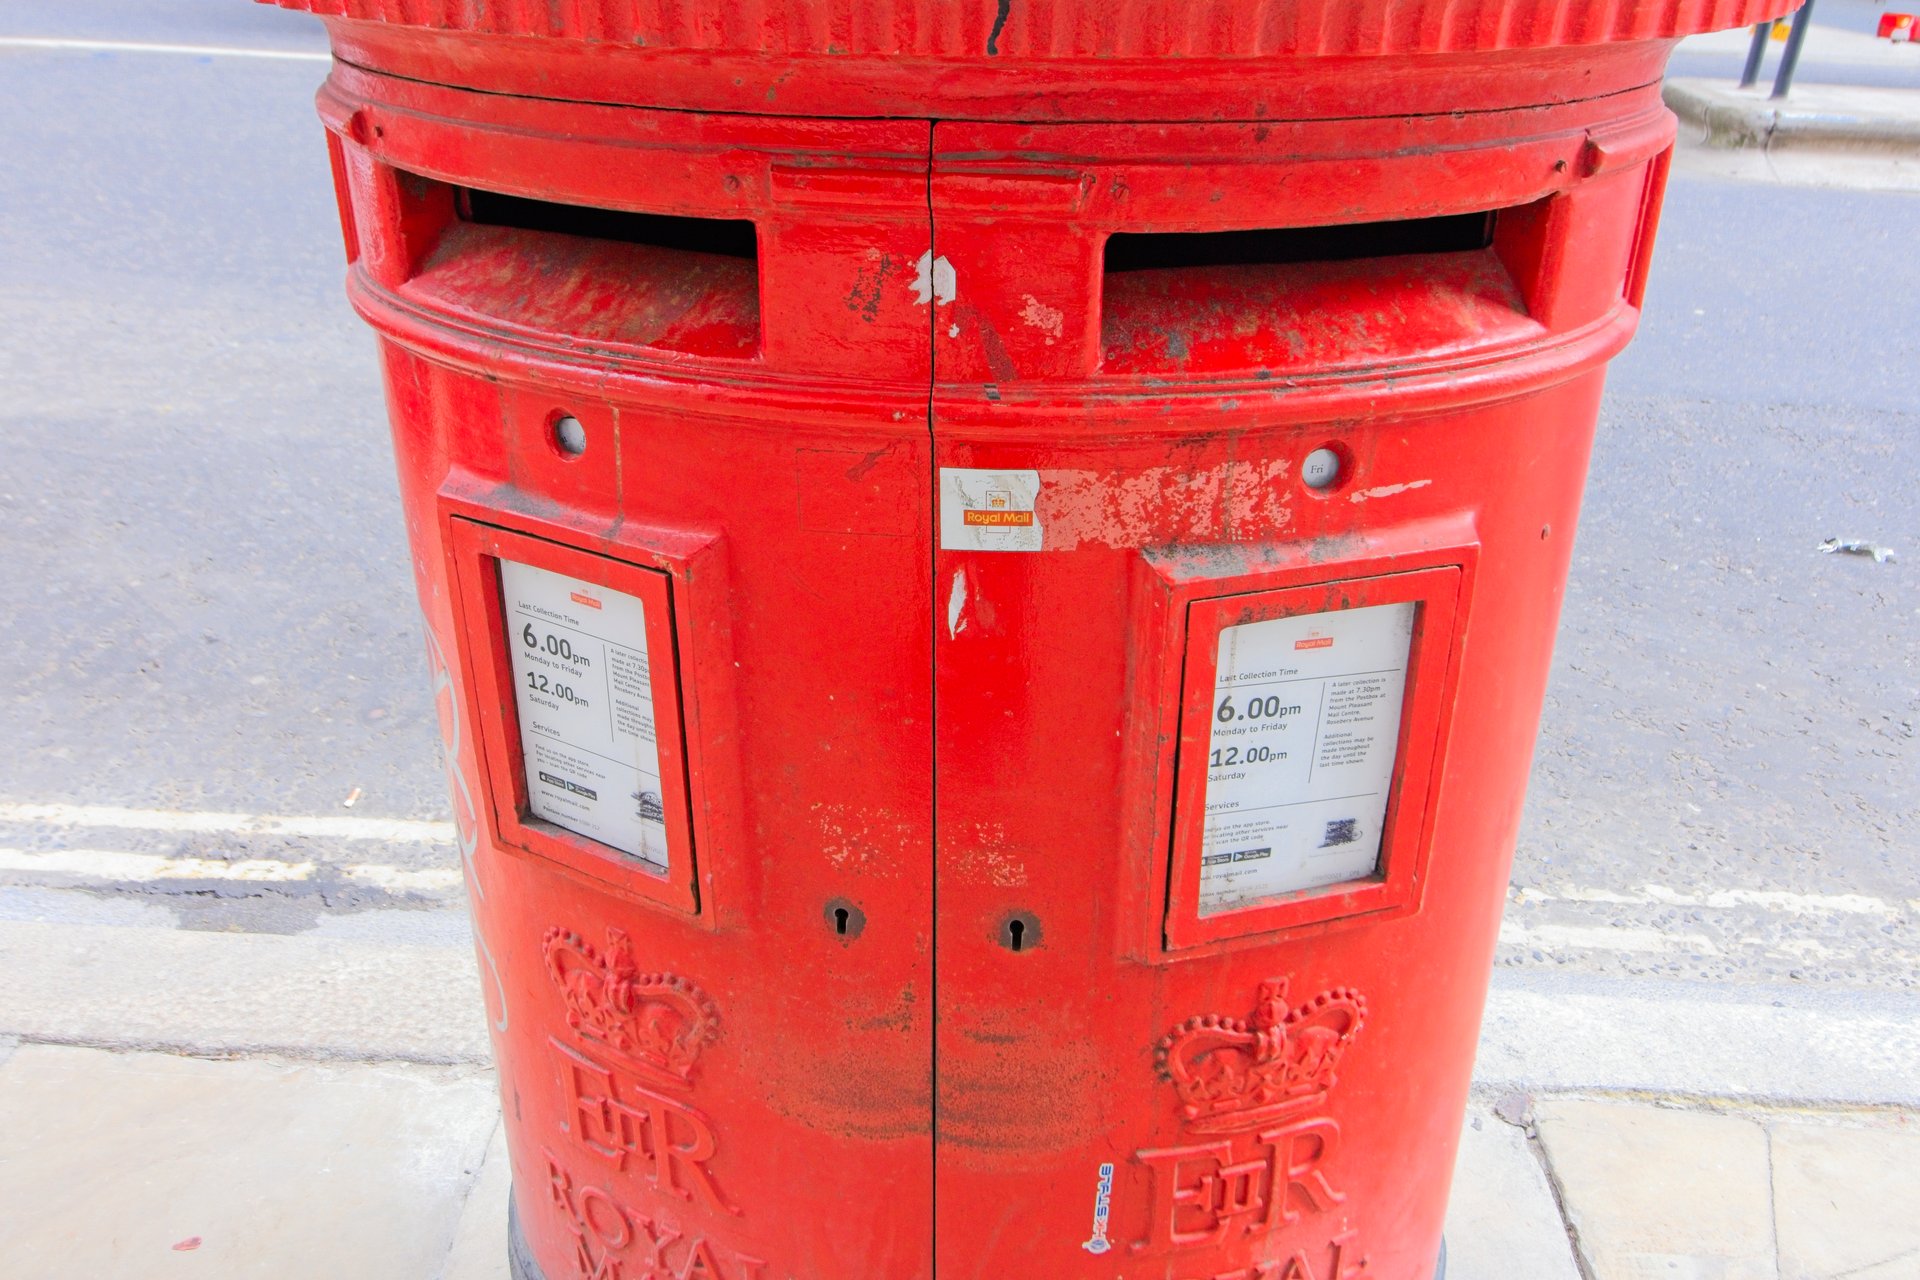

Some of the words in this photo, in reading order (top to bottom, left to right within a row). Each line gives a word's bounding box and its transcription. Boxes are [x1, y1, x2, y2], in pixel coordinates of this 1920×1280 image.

[1310, 464, 1324, 474] Fri
[967, 511, 1001, 525] Royal
[1003, 513, 1030, 524] Mail
[518, 601, 532, 612] Last
[533, 605, 563, 621] Collection
[563, 615, 580, 626] Time
[523, 622, 591, 667] 6.00pm
[524, 652, 550, 668] Monday
[552, 660, 559, 669] to
[561, 664, 583, 678] Friday
[628, 654, 647, 665] collectio
[631, 662, 650, 674] 7.30p
[1219, 673, 1237, 683] Last
[1239, 669, 1277, 681] Collection
[1279, 667, 1299, 676] Time
[1353, 678, 1380, 686] collection
[527, 671, 589, 708] 12.00pm
[529, 694, 560, 711] Saturday
[1217, 695, 1302, 723] 6.00pm
[532, 721, 561, 737] Services
[1213, 724, 1247, 737] Monday
[1250, 725, 1258, 734] to
[1260, 722, 1288, 734] Friday
[1324, 731, 1353, 740] Additional
[1323, 738, 1352, 747] collections
[1338, 743, 1370, 752] throughout
[1209, 746, 1288, 768] 12.00pm
[1208, 771, 1246, 783] Saturday
[1204, 801, 1240, 811] Services
